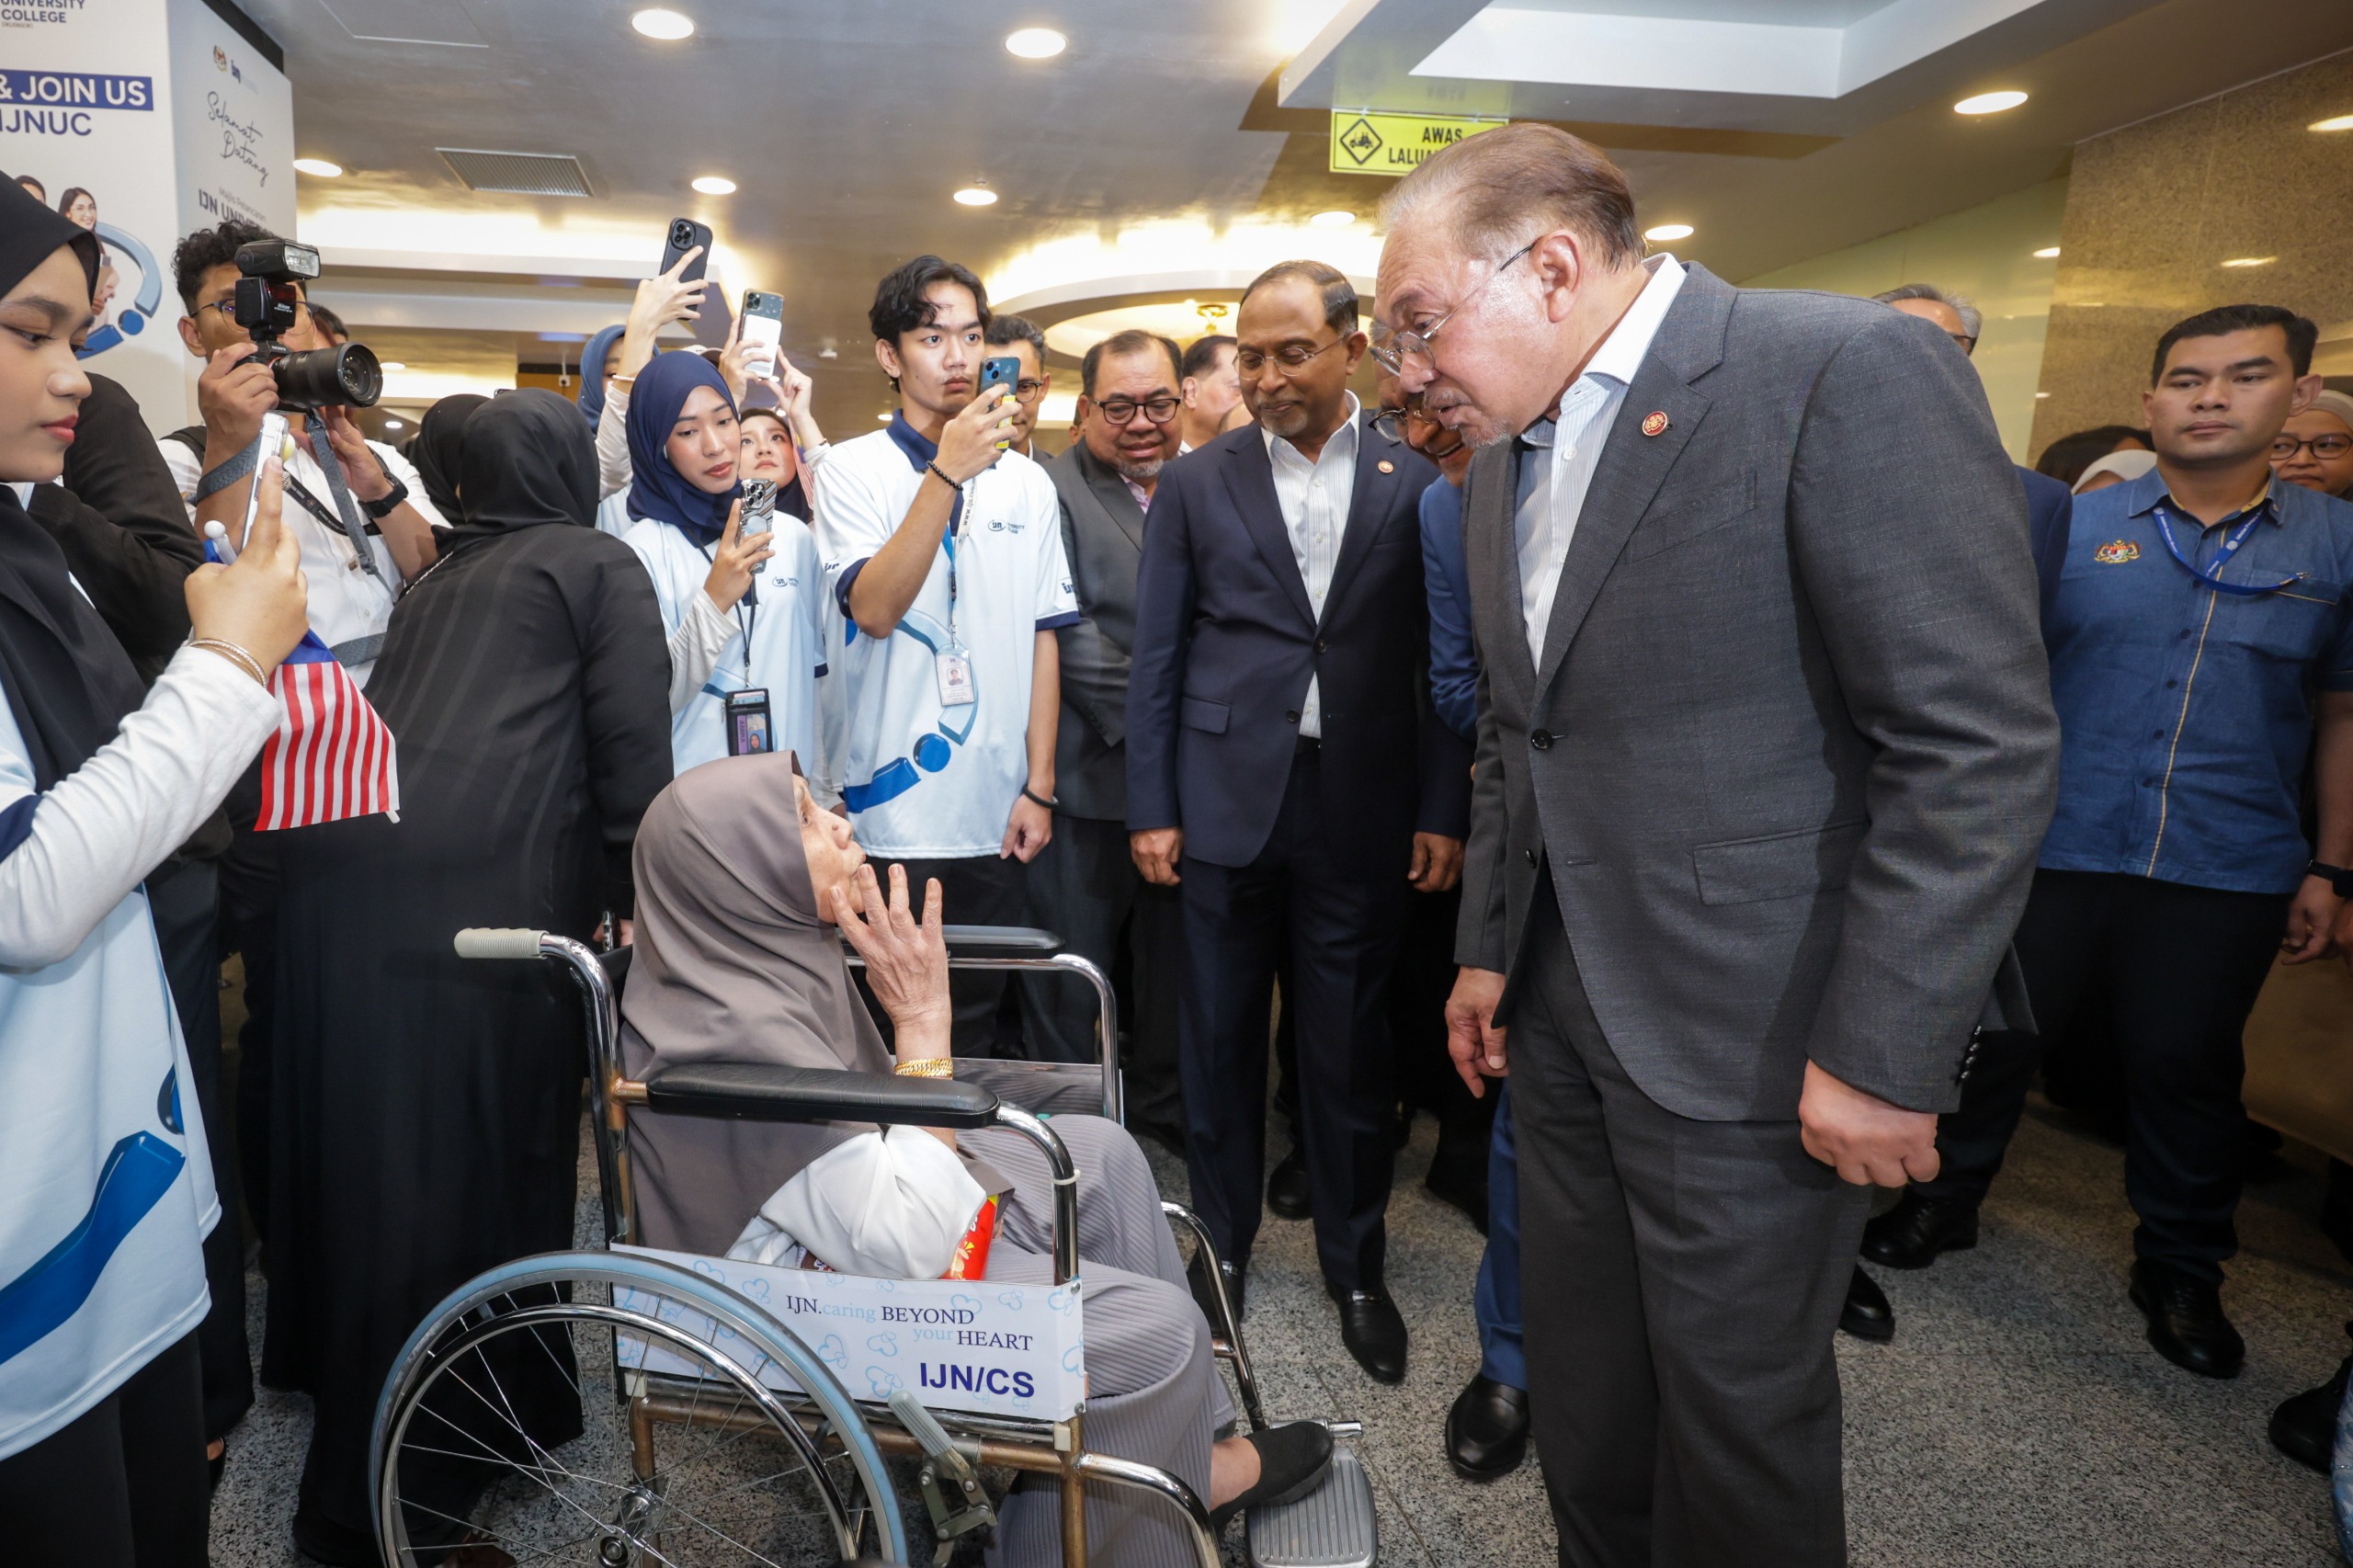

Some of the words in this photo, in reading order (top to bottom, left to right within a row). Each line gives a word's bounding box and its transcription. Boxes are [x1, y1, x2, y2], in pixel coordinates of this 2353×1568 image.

[1, 8, 66, 23] COLLEGE
[20, 75, 96, 104] JOIN
[105, 79, 146, 107] US
[208, 91, 264, 143] Selamat
[1422, 126, 1463, 143] AWAS
[220, 131, 268, 187] Datang
[881, 1306, 975, 1324] BEYOND
[912, 1328, 954, 1343] your
[957, 1330, 1033, 1351] HEART
[920, 1362, 1035, 1398] IJN/CS
